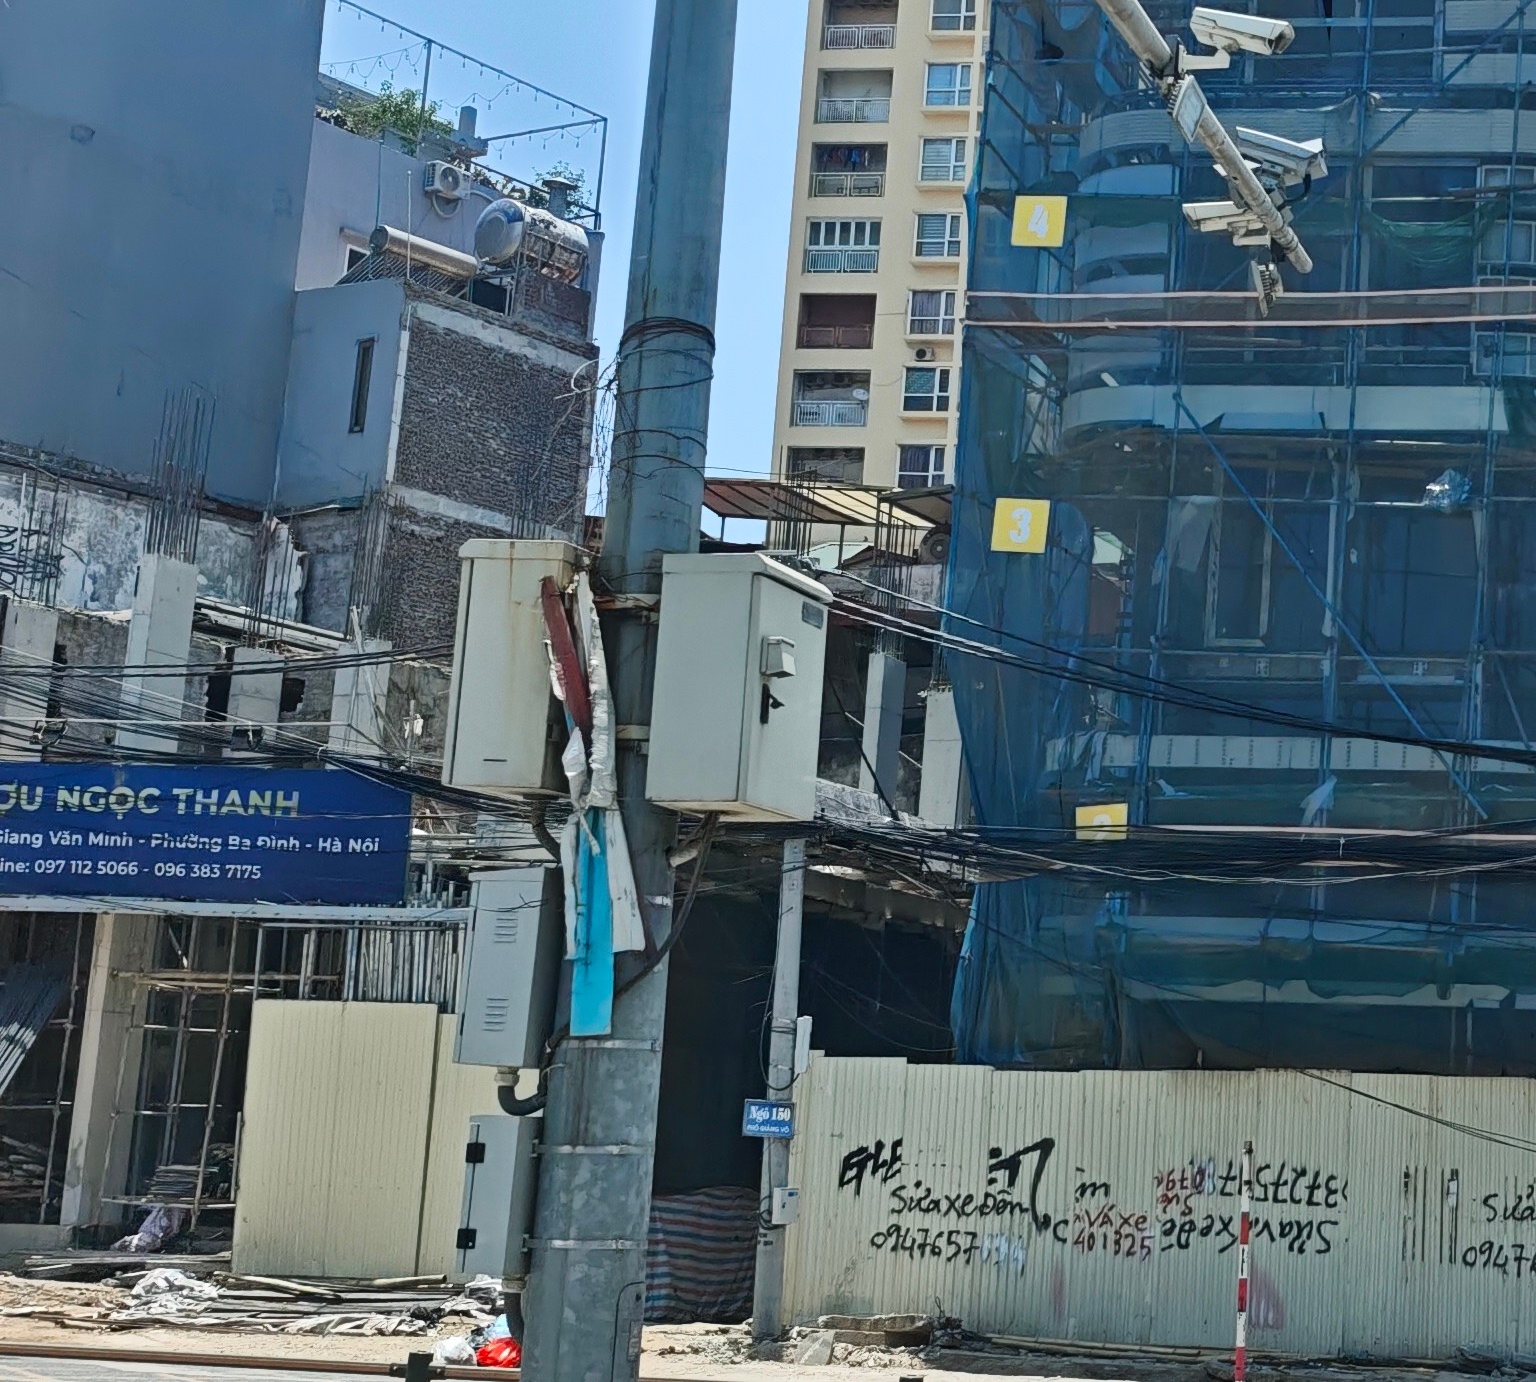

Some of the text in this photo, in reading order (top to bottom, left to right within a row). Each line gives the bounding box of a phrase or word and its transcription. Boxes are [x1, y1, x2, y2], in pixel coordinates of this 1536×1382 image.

[1028, 204, 1049, 239] 4
[1008, 506, 1033, 544] 3
[56, 785, 162, 820] NGỌC
[172, 787, 299, 817] THANH
[49, 830, 83, 847] Văn
[88, 830, 133, 847] Minh
[150, 832, 222, 852] Phường
[227, 835, 251, 850] Ba
[256, 834, 300, 851] Đình
[318, 836, 342, 852] Hà
[348, 837, 380, 857] Nội
[34, 859, 66, 874] 097
[70, 860, 92, 875] 112
[96, 861, 139, 876] 5066
[154, 863, 186, 877] 096
[190, 863, 220, 878] 383
[225, 864, 261, 879] 7175
[772, 1107, 791, 1121] 150
